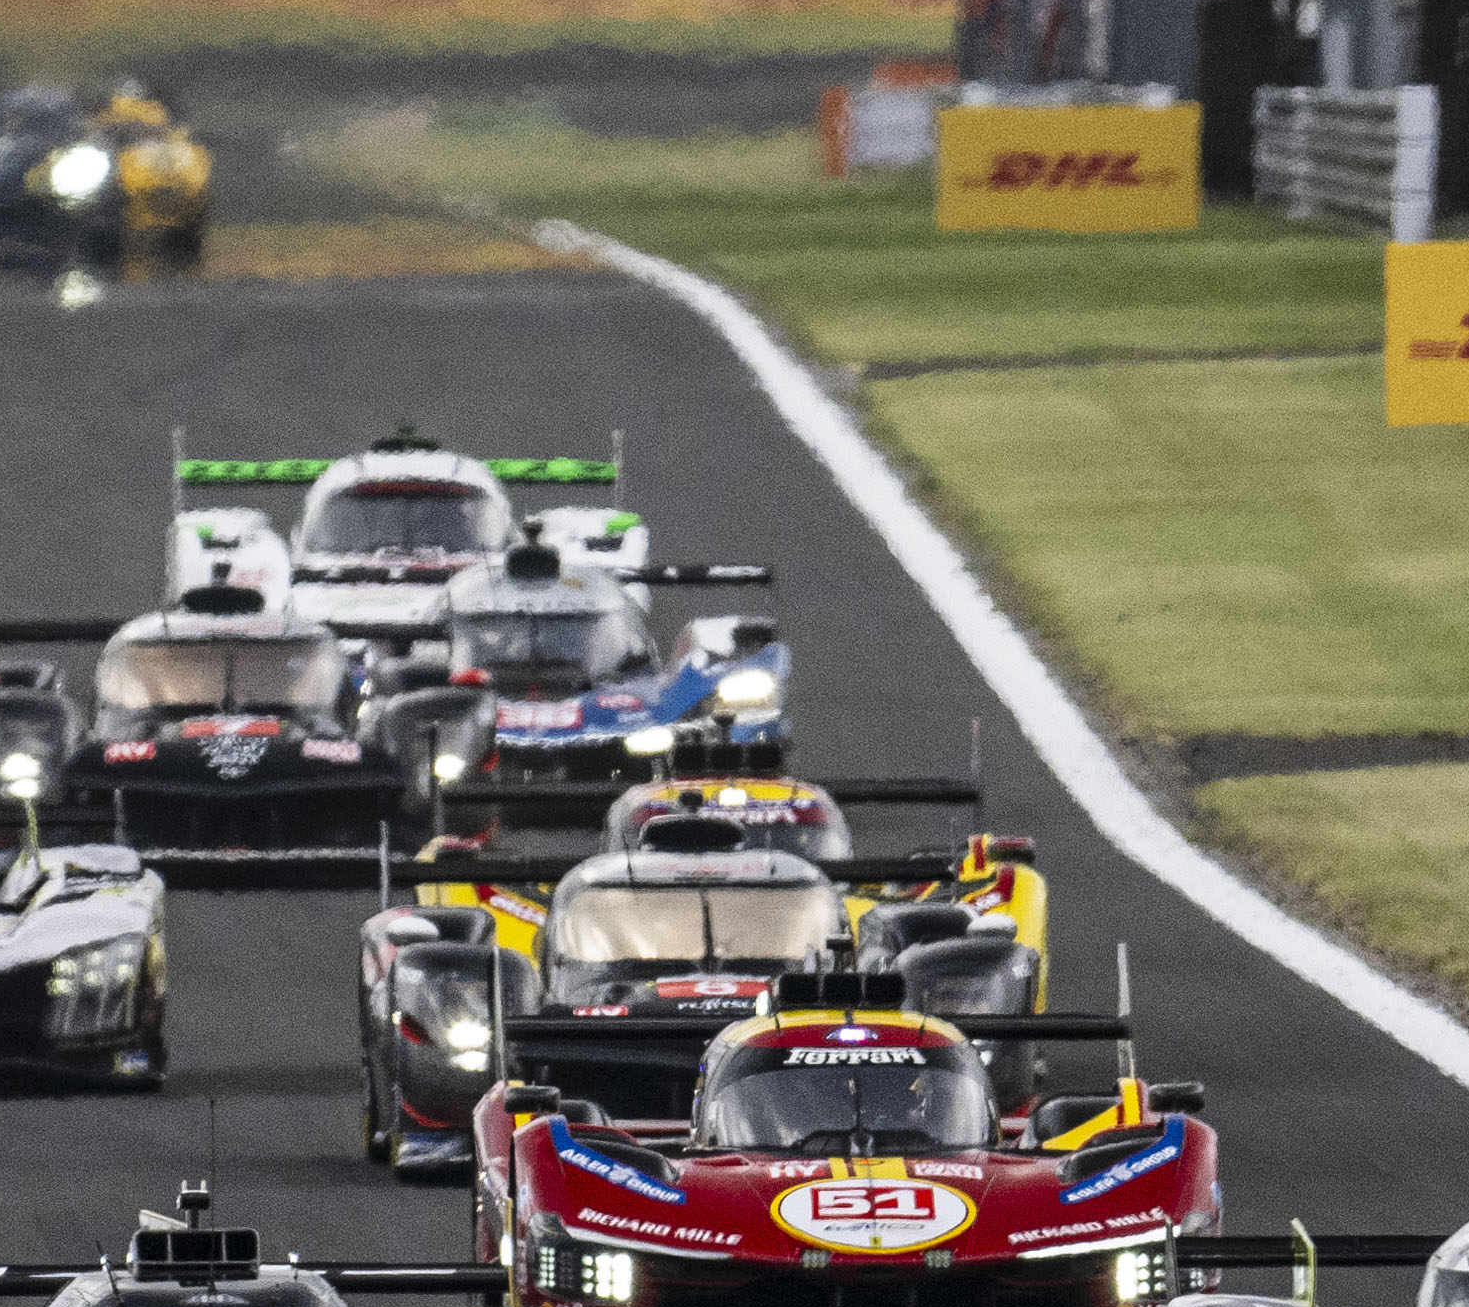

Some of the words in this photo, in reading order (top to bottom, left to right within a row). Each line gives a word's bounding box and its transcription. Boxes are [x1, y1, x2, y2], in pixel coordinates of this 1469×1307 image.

[985, 150, 1144, 191] DHL
[783, 1047, 927, 1066] Ferrari
[559, 1148, 611, 1174] ADLER
[626, 1177, 682, 1202] GROUP
[1066, 1175, 1115, 1202] ADLER
[1129, 1145, 1179, 1173] GROUP
[817, 1188, 931, 1216] 51
[578, 1206, 673, 1236] RICHARD
[673, 1227, 744, 1247] MILLE
[1008, 1222, 1104, 1245] RICHARD
[1104, 1205, 1166, 1229] MILLE
